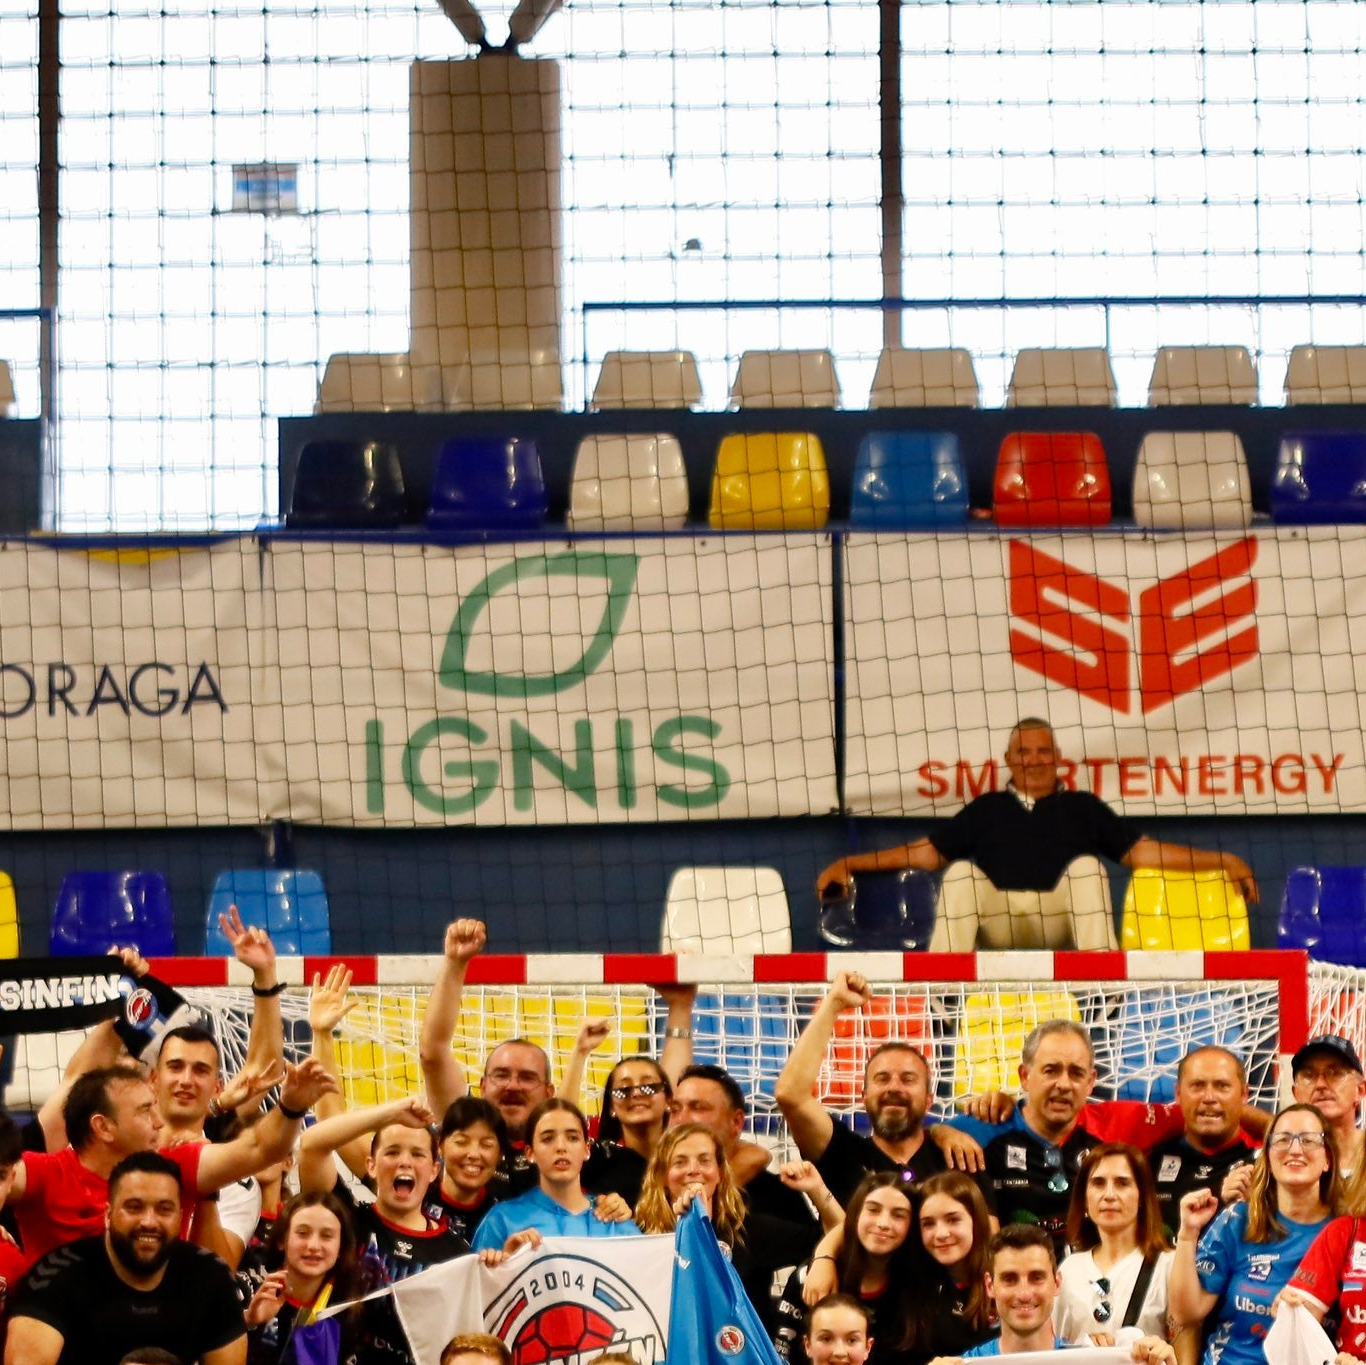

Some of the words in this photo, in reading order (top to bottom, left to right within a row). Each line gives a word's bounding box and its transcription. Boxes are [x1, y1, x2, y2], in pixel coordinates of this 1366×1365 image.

[365, 714, 731, 815] IGNIS
[916, 752, 1346, 800] SMRTENERGY
[529, 1270, 585, 1298] 2004
